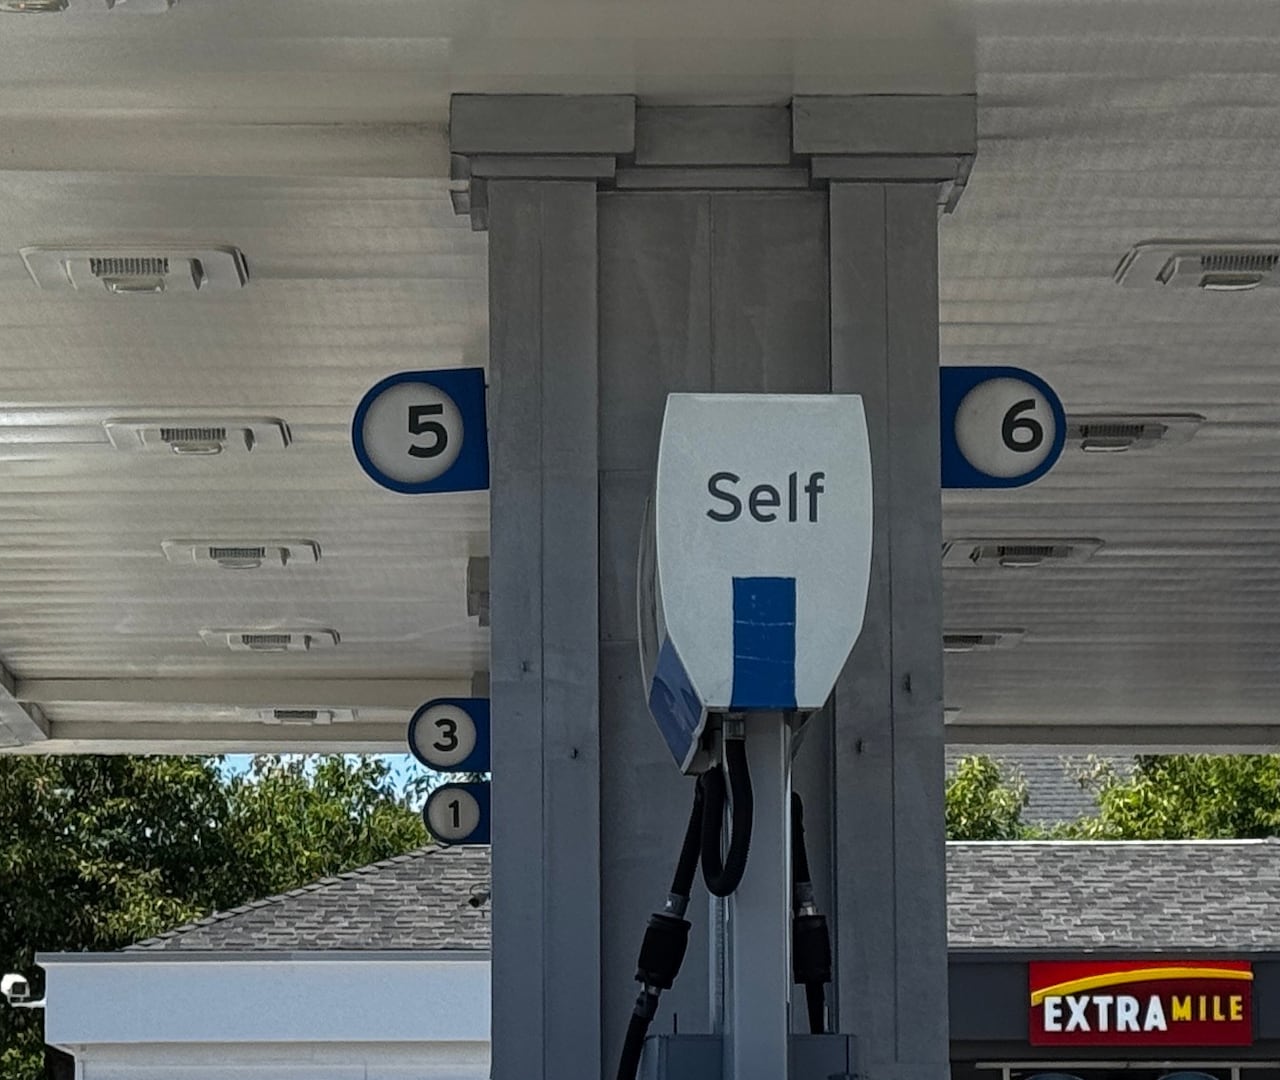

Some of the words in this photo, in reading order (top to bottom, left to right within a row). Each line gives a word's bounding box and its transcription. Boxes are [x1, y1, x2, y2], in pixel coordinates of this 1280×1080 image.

[407, 403, 448, 459] 5
[1001, 398, 1043, 453] 6
[705, 470, 825, 523] Self
[433, 717, 458, 751] 3
[447, 800, 461, 828] 1
